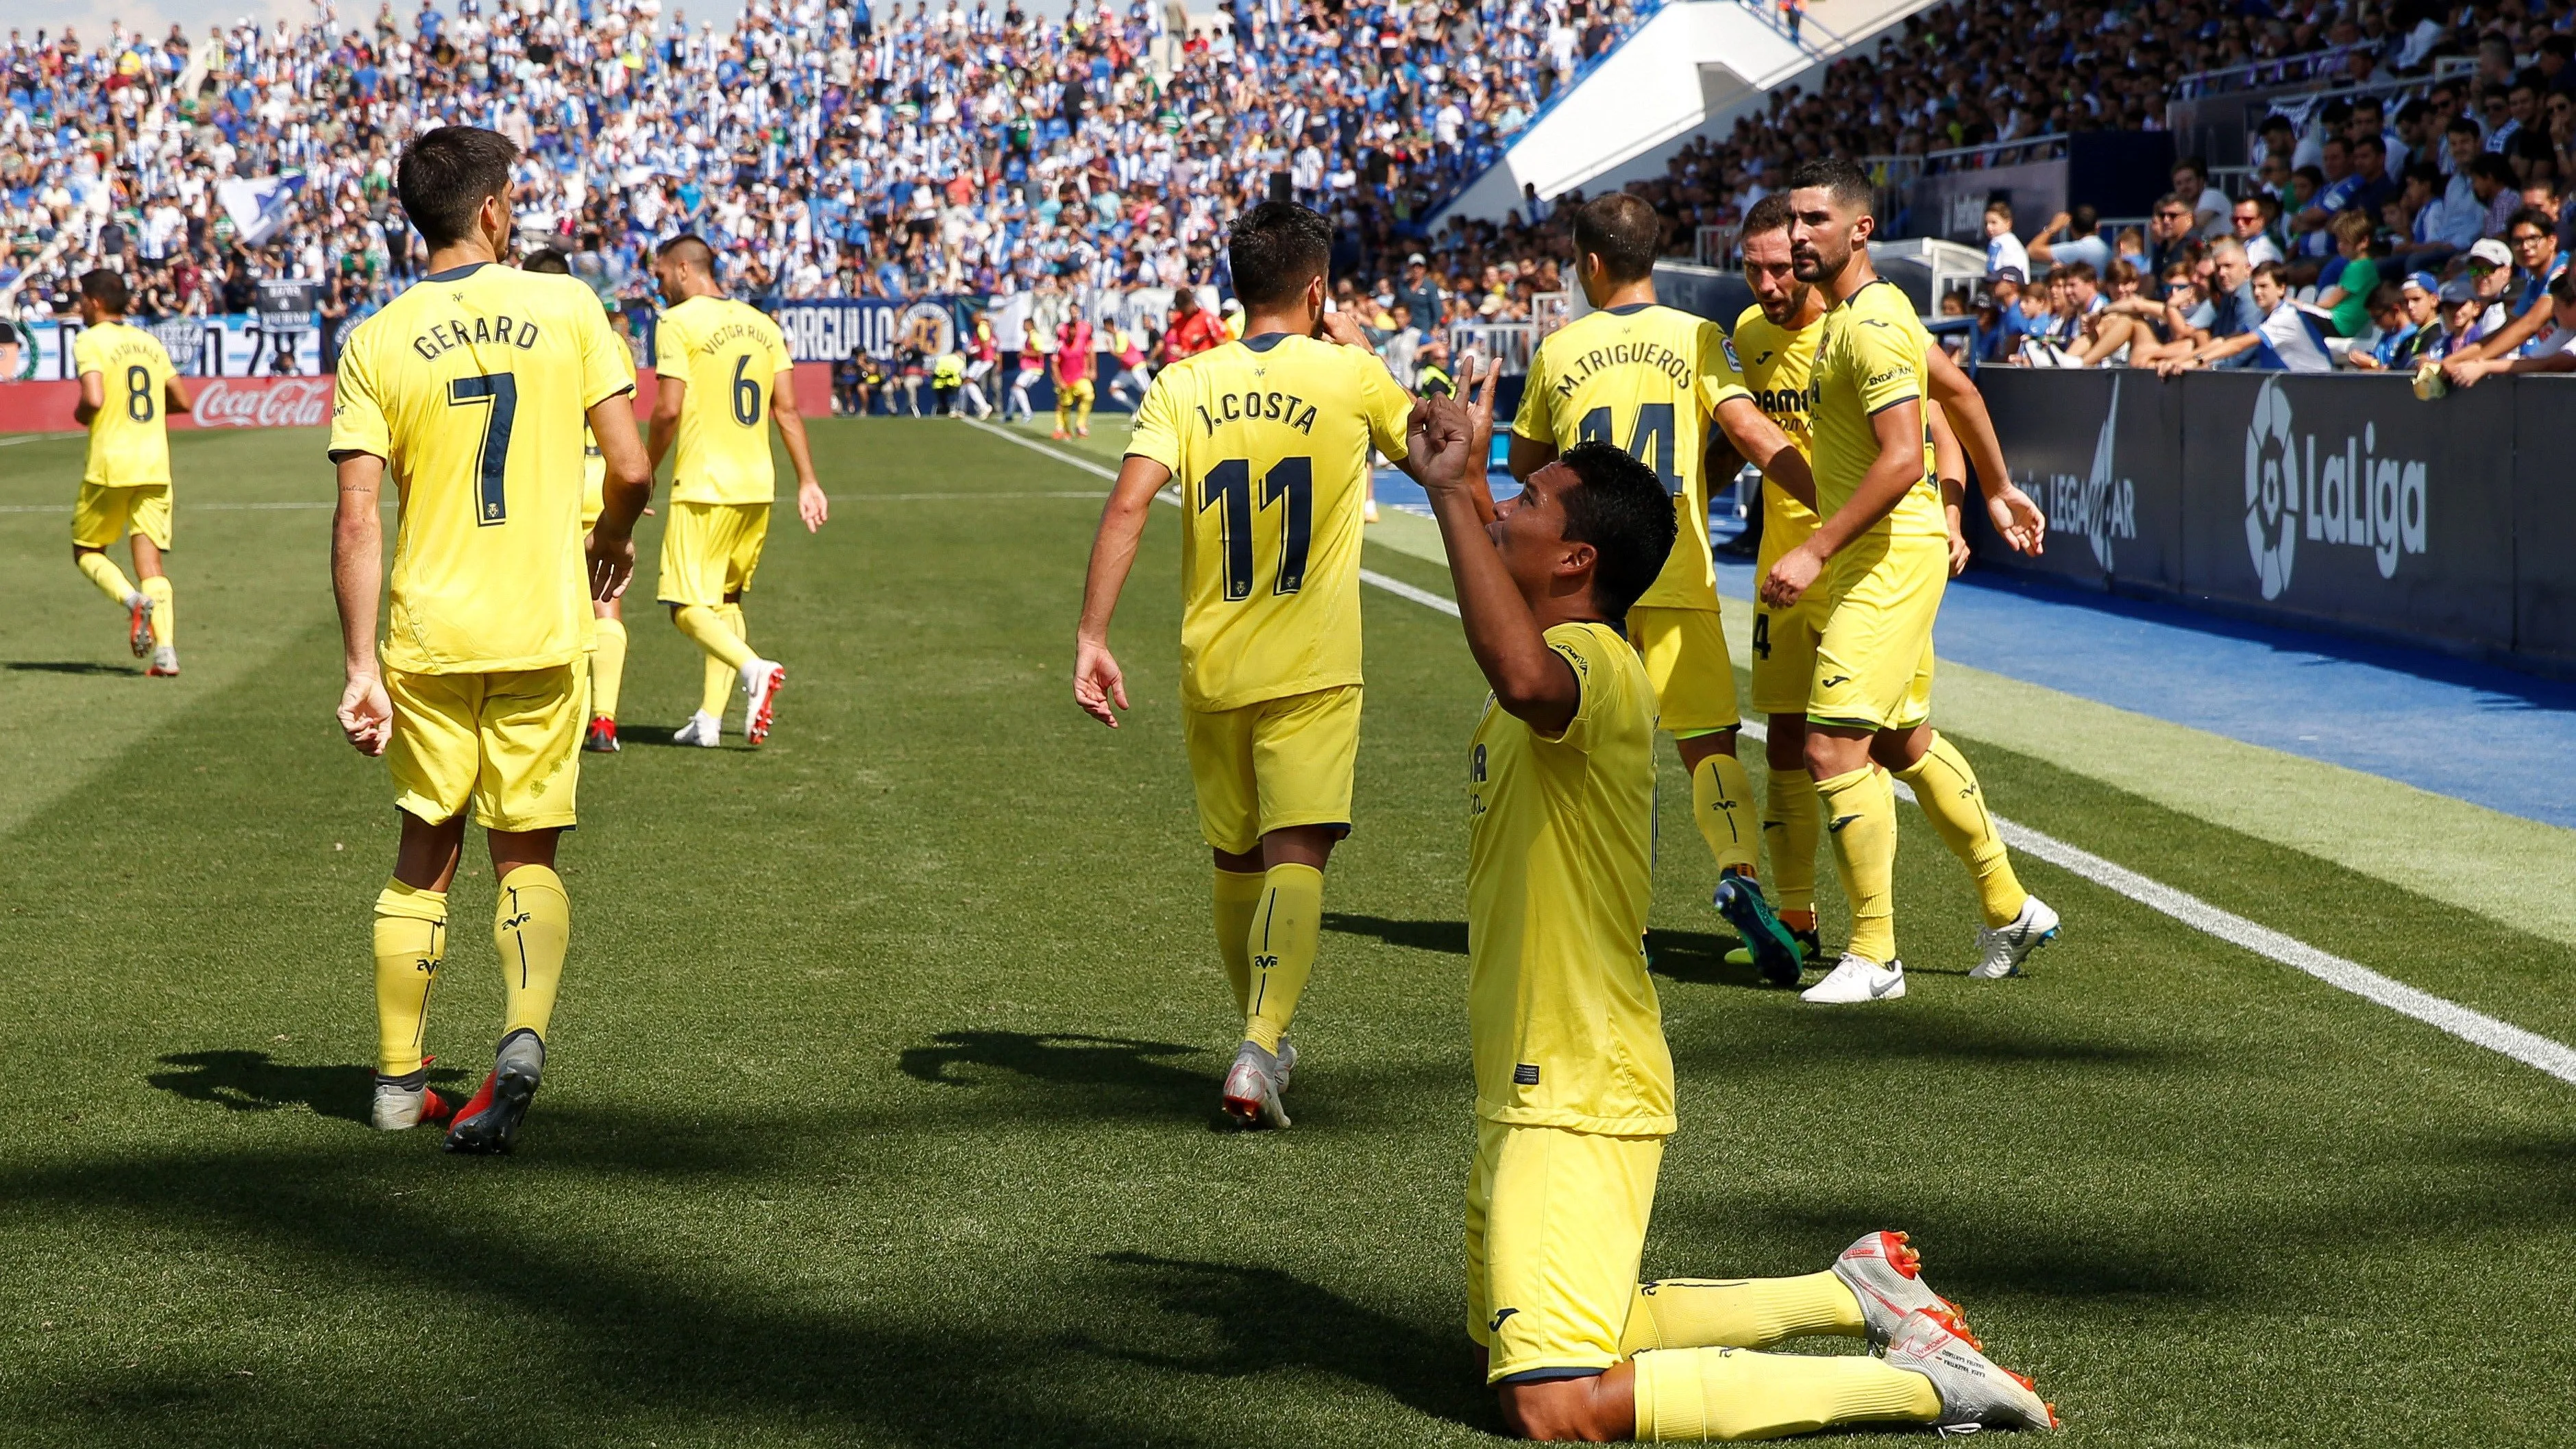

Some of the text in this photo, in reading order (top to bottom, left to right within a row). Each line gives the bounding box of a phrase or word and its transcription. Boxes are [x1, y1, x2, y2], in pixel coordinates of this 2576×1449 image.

[413, 315, 540, 362] GERARD
[700, 324, 774, 356] VICTOR RUIZ
[125, 364, 155, 425] 8
[729, 353, 761, 430] 6
[1557, 342, 1693, 398] M.TRIGUEROS
[193, 378, 331, 427] Coca-Cola
[1195, 391, 1318, 439] J.COSTA
[446, 371, 517, 528] 7
[2306, 420, 2427, 579] LaLiga
[1198, 456, 1312, 602] 11
